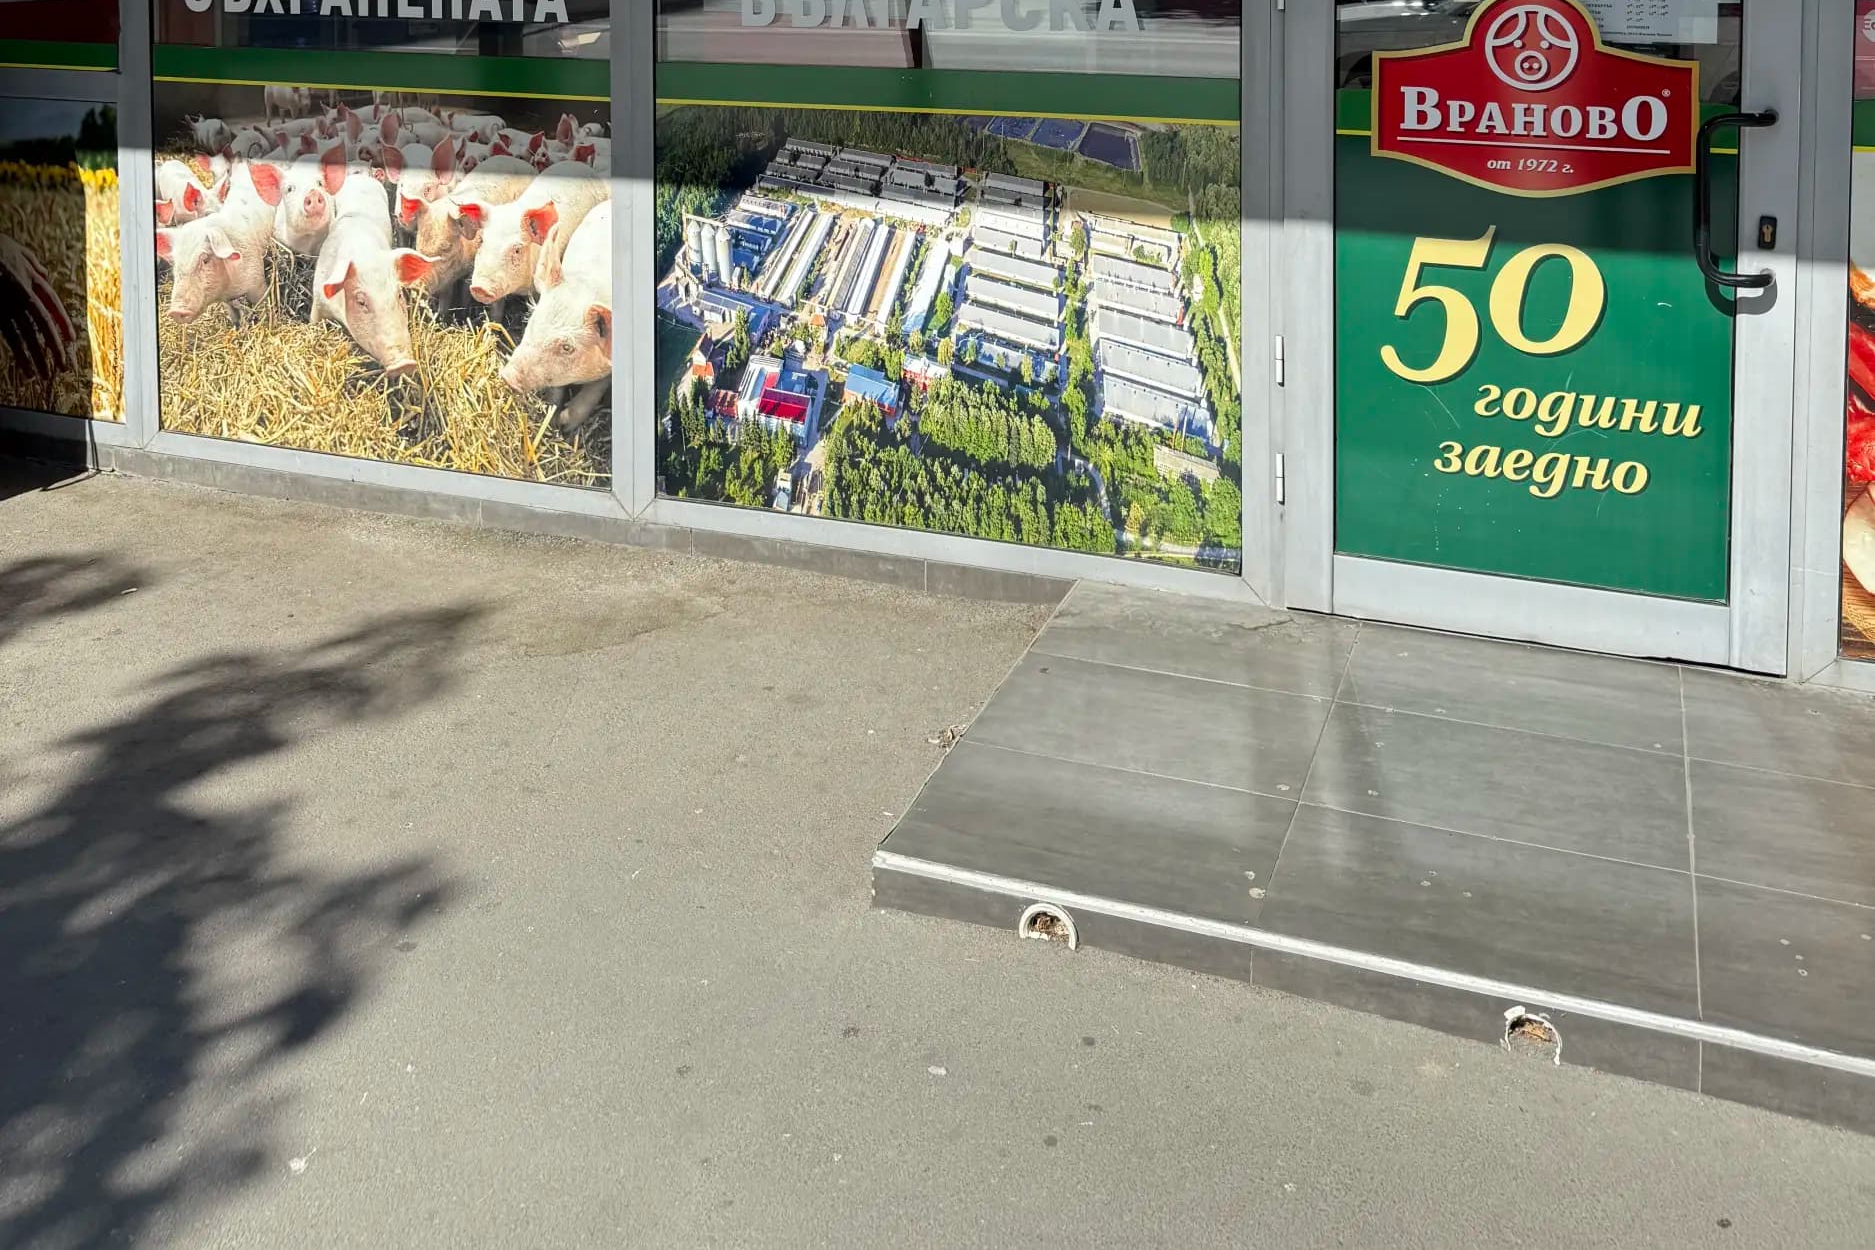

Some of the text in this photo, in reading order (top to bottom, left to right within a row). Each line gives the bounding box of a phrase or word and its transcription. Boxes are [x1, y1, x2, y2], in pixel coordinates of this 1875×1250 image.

[1486, 158, 1511, 171] от
[1516, 158, 1559, 174] 1972
[1380, 225, 1607, 385] 50
[1473, 383, 1704, 438] години
[1433, 440, 1651, 499] заедно
